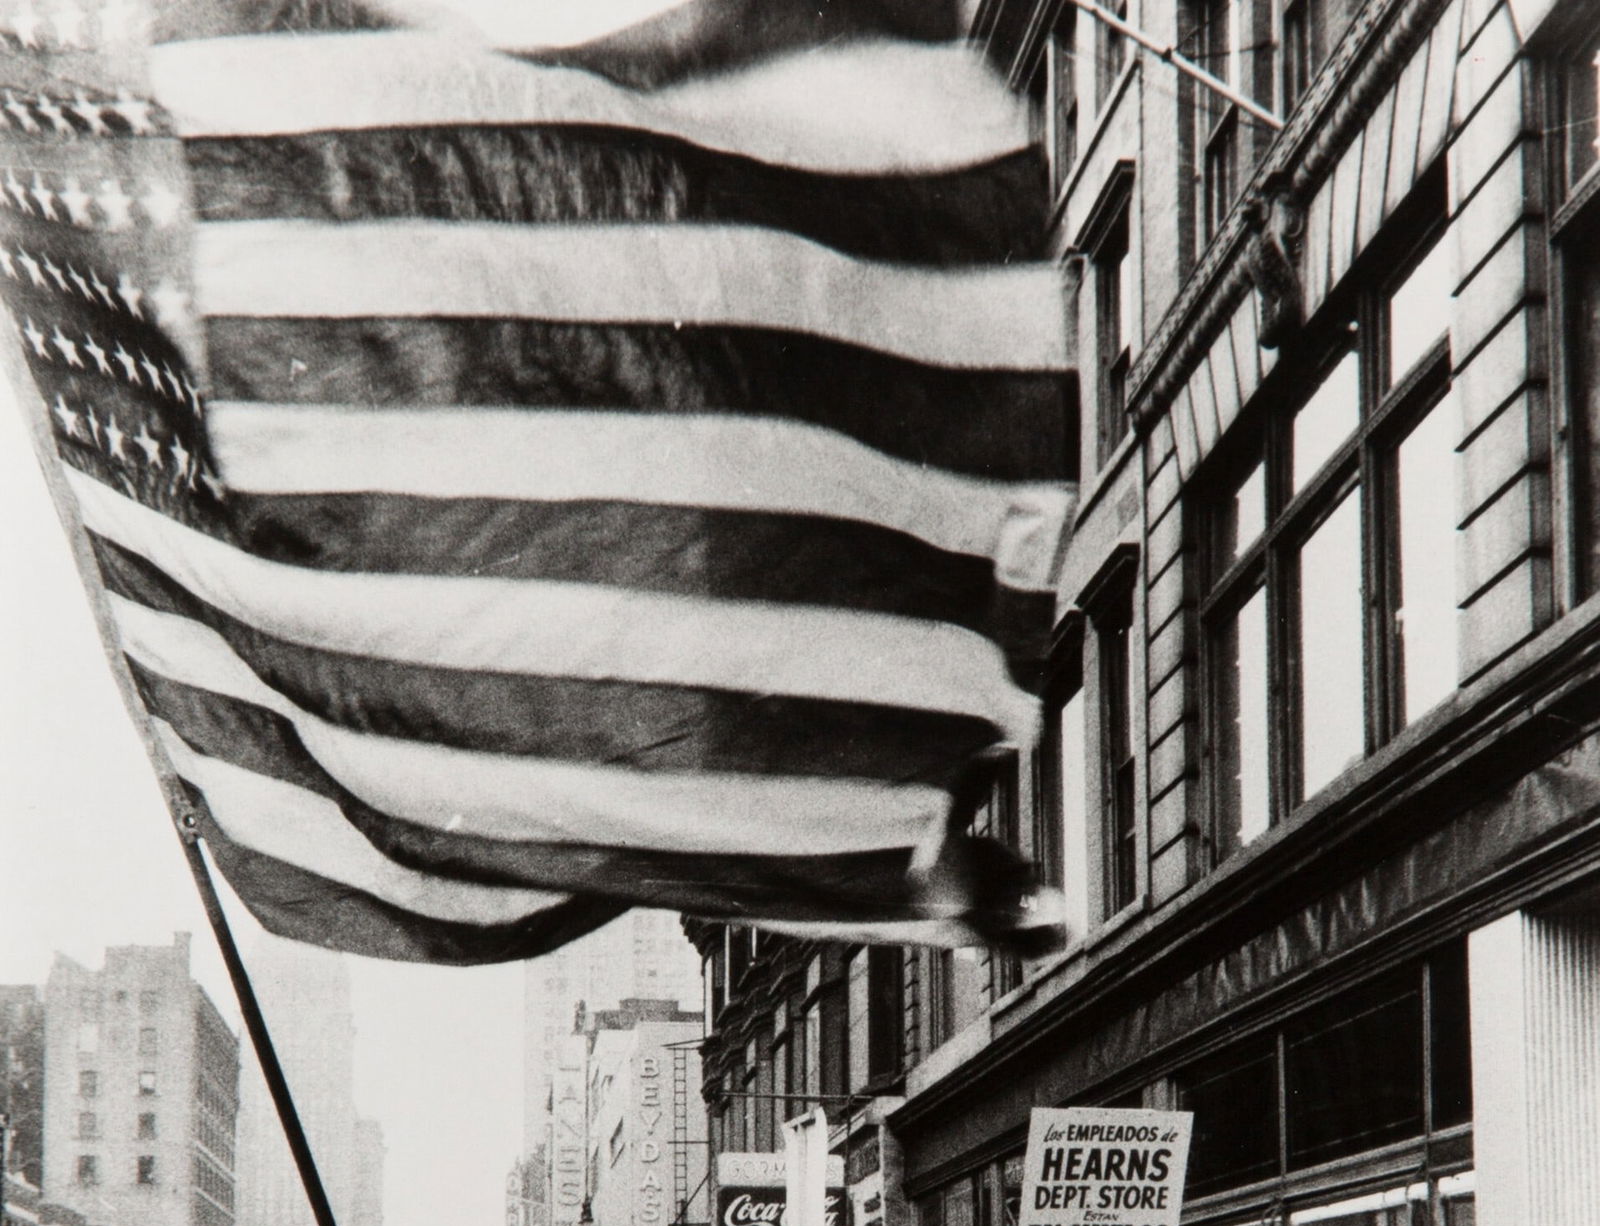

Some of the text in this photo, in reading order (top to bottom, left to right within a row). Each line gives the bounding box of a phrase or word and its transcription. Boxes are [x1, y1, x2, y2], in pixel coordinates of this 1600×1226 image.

[1043, 1124, 1178, 1143] Los EMPLEADOS de
[1041, 1148, 1172, 1182] HEARNS
[1034, 1186, 1169, 1210] DEPT. STORE
